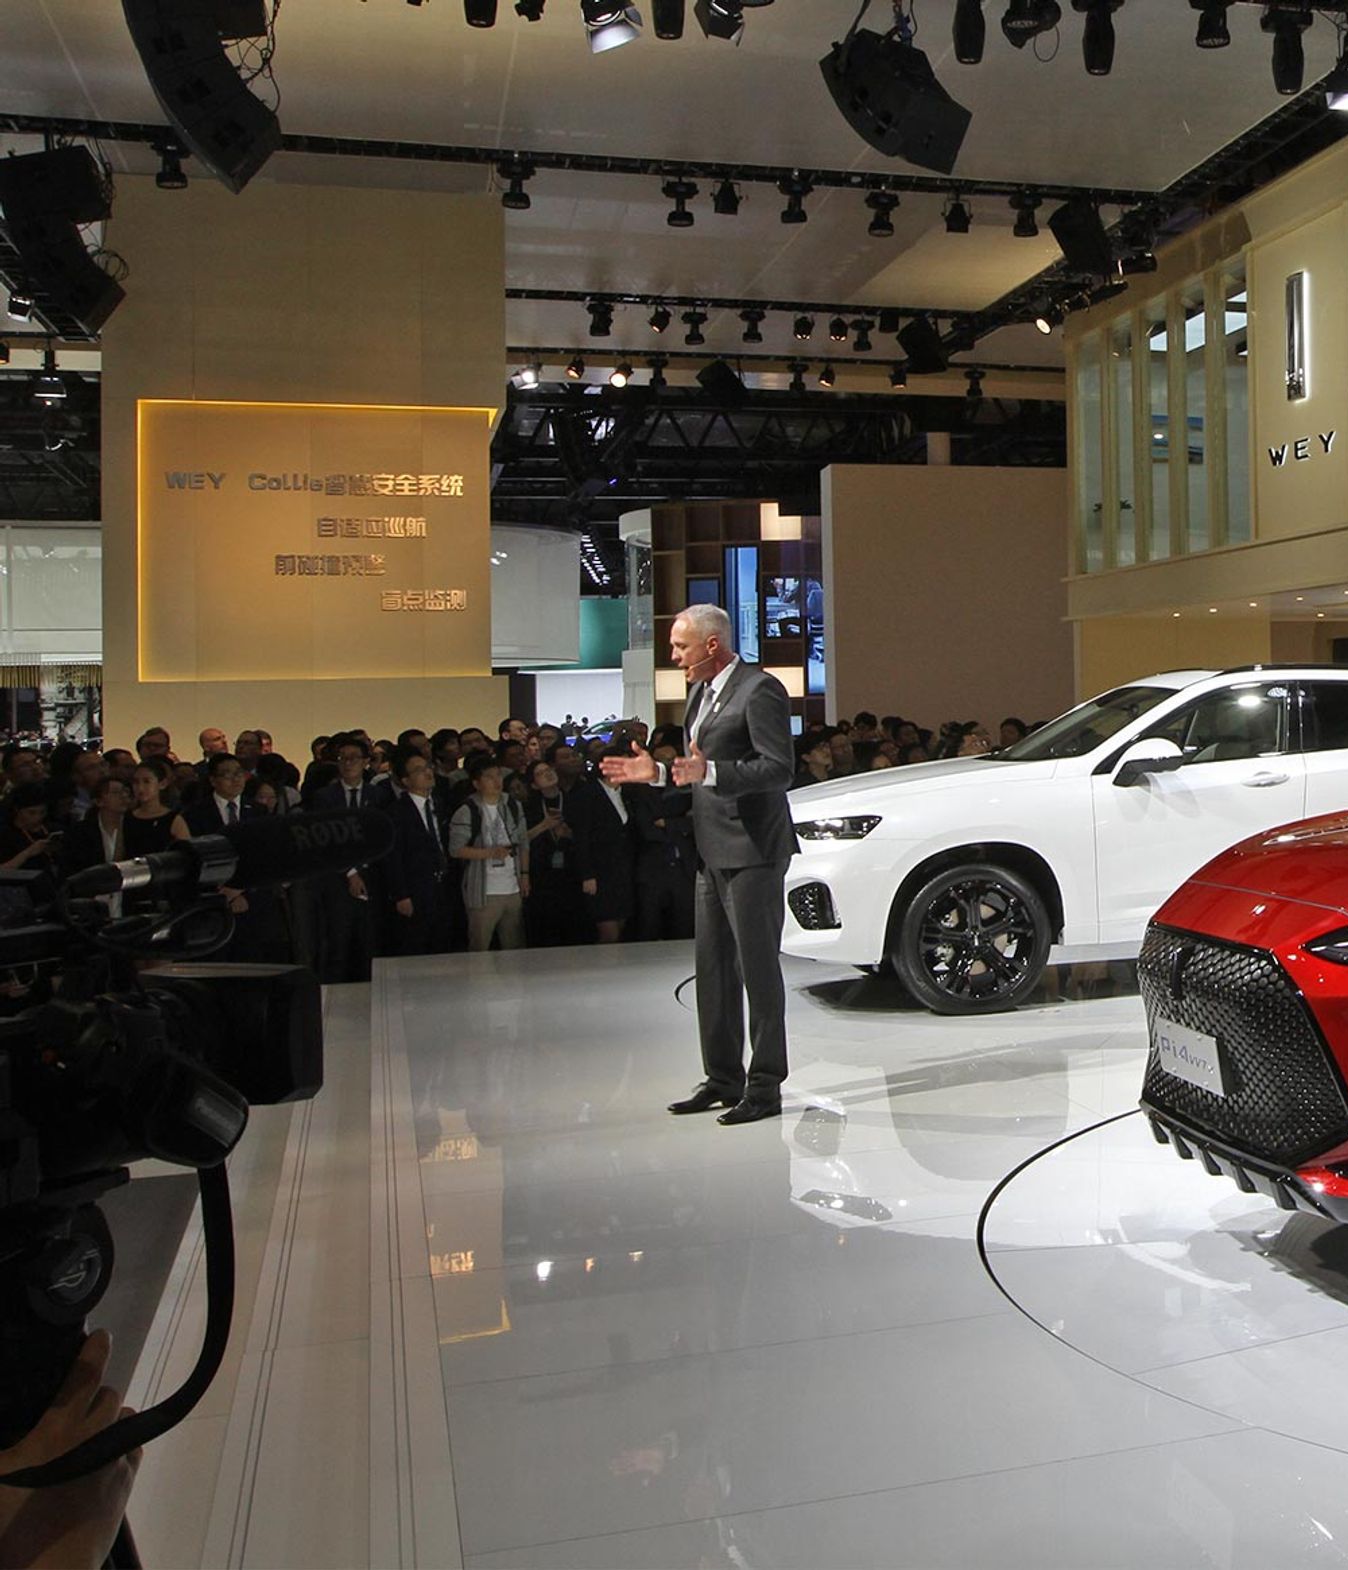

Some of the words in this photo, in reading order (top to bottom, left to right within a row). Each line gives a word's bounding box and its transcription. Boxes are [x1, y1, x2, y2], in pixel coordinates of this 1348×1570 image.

[1268, 431, 1336, 467] WEY
[164, 471, 227, 491] WEY
[317, 516, 427, 539] 自适应巡航
[380, 589, 467, 612] 盲点监测
